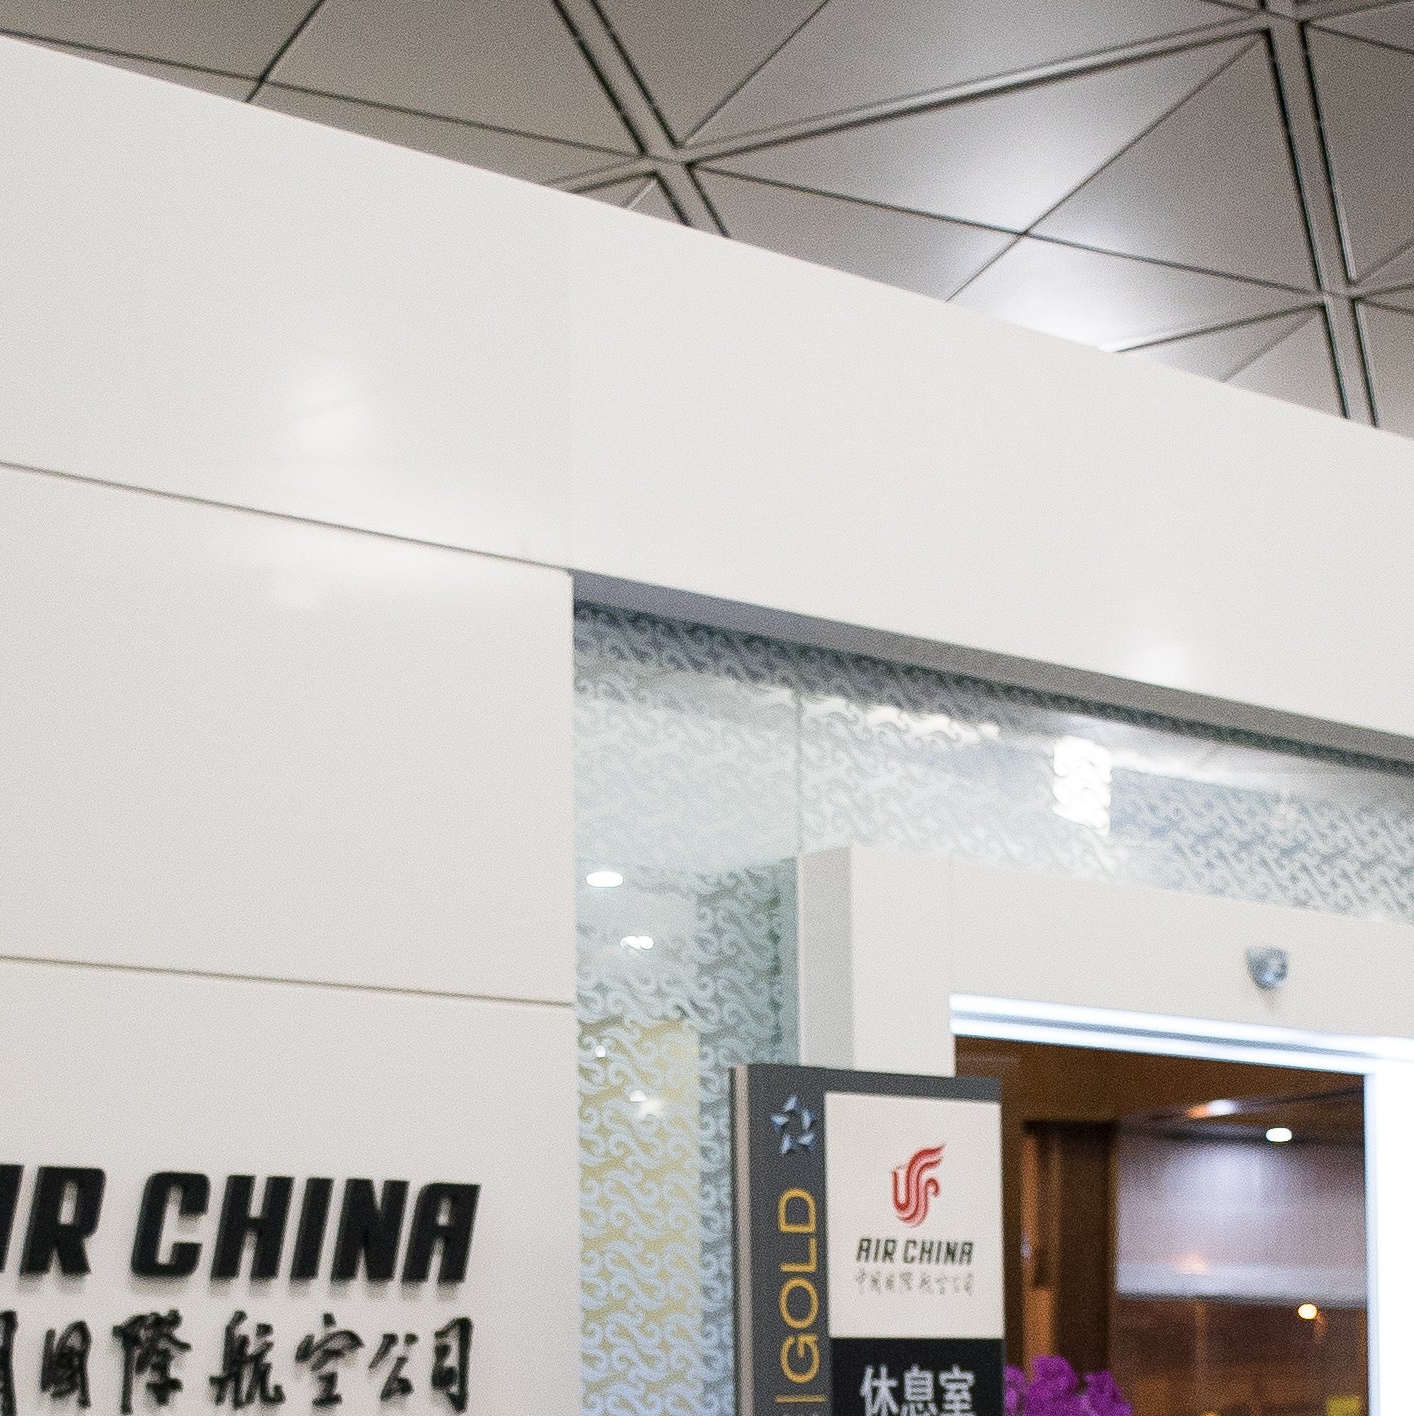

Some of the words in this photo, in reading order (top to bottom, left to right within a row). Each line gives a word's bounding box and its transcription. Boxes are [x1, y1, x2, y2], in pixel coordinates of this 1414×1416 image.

[129, 1170, 481, 1285] CHINA
[777, 1186, 821, 1384] GOLD
[855, 1237, 898, 1265] AIR
[902, 1238, 975, 1266] CHINA
